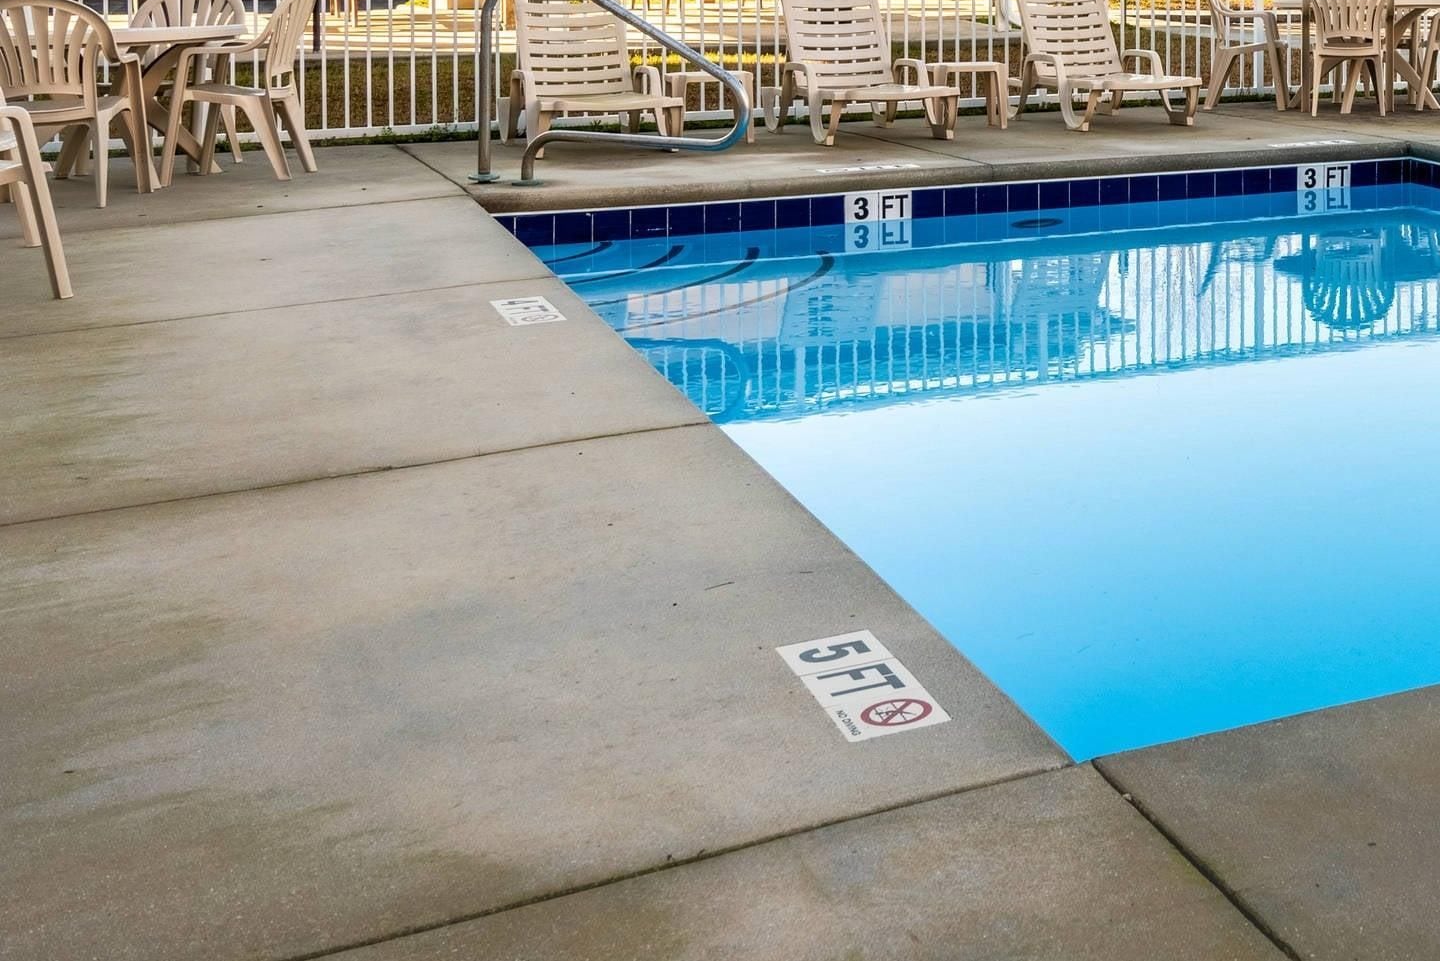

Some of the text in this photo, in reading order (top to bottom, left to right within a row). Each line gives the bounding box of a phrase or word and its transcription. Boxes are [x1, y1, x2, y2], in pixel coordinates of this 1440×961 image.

[1304, 166, 1349, 189] 3 FT
[853, 194, 909, 220] 3 FT
[799, 640, 906, 697] 5 FT
